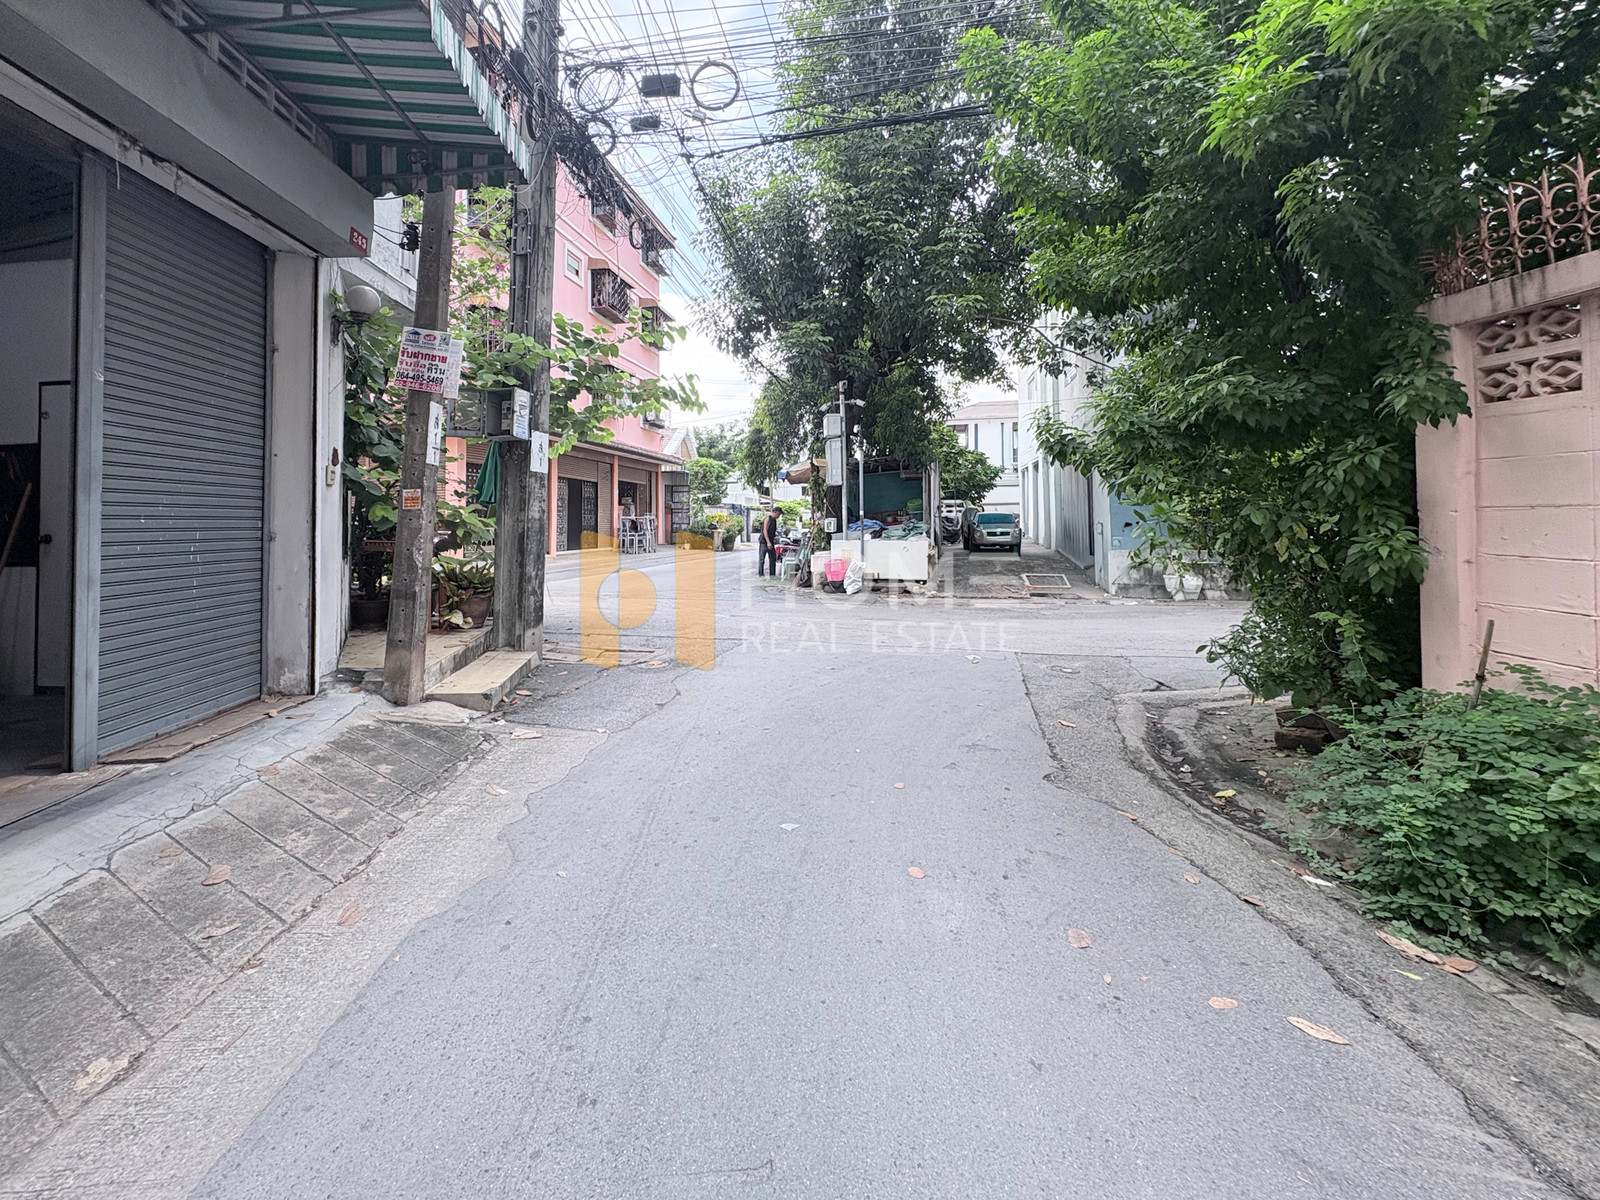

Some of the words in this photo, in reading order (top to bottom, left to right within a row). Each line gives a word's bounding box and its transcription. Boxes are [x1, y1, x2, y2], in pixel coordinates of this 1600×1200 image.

[352, 231, 367, 249] 245
[401, 347, 447, 363] รับฝากขาย
[396, 371, 444, 385] 064-495-5469
